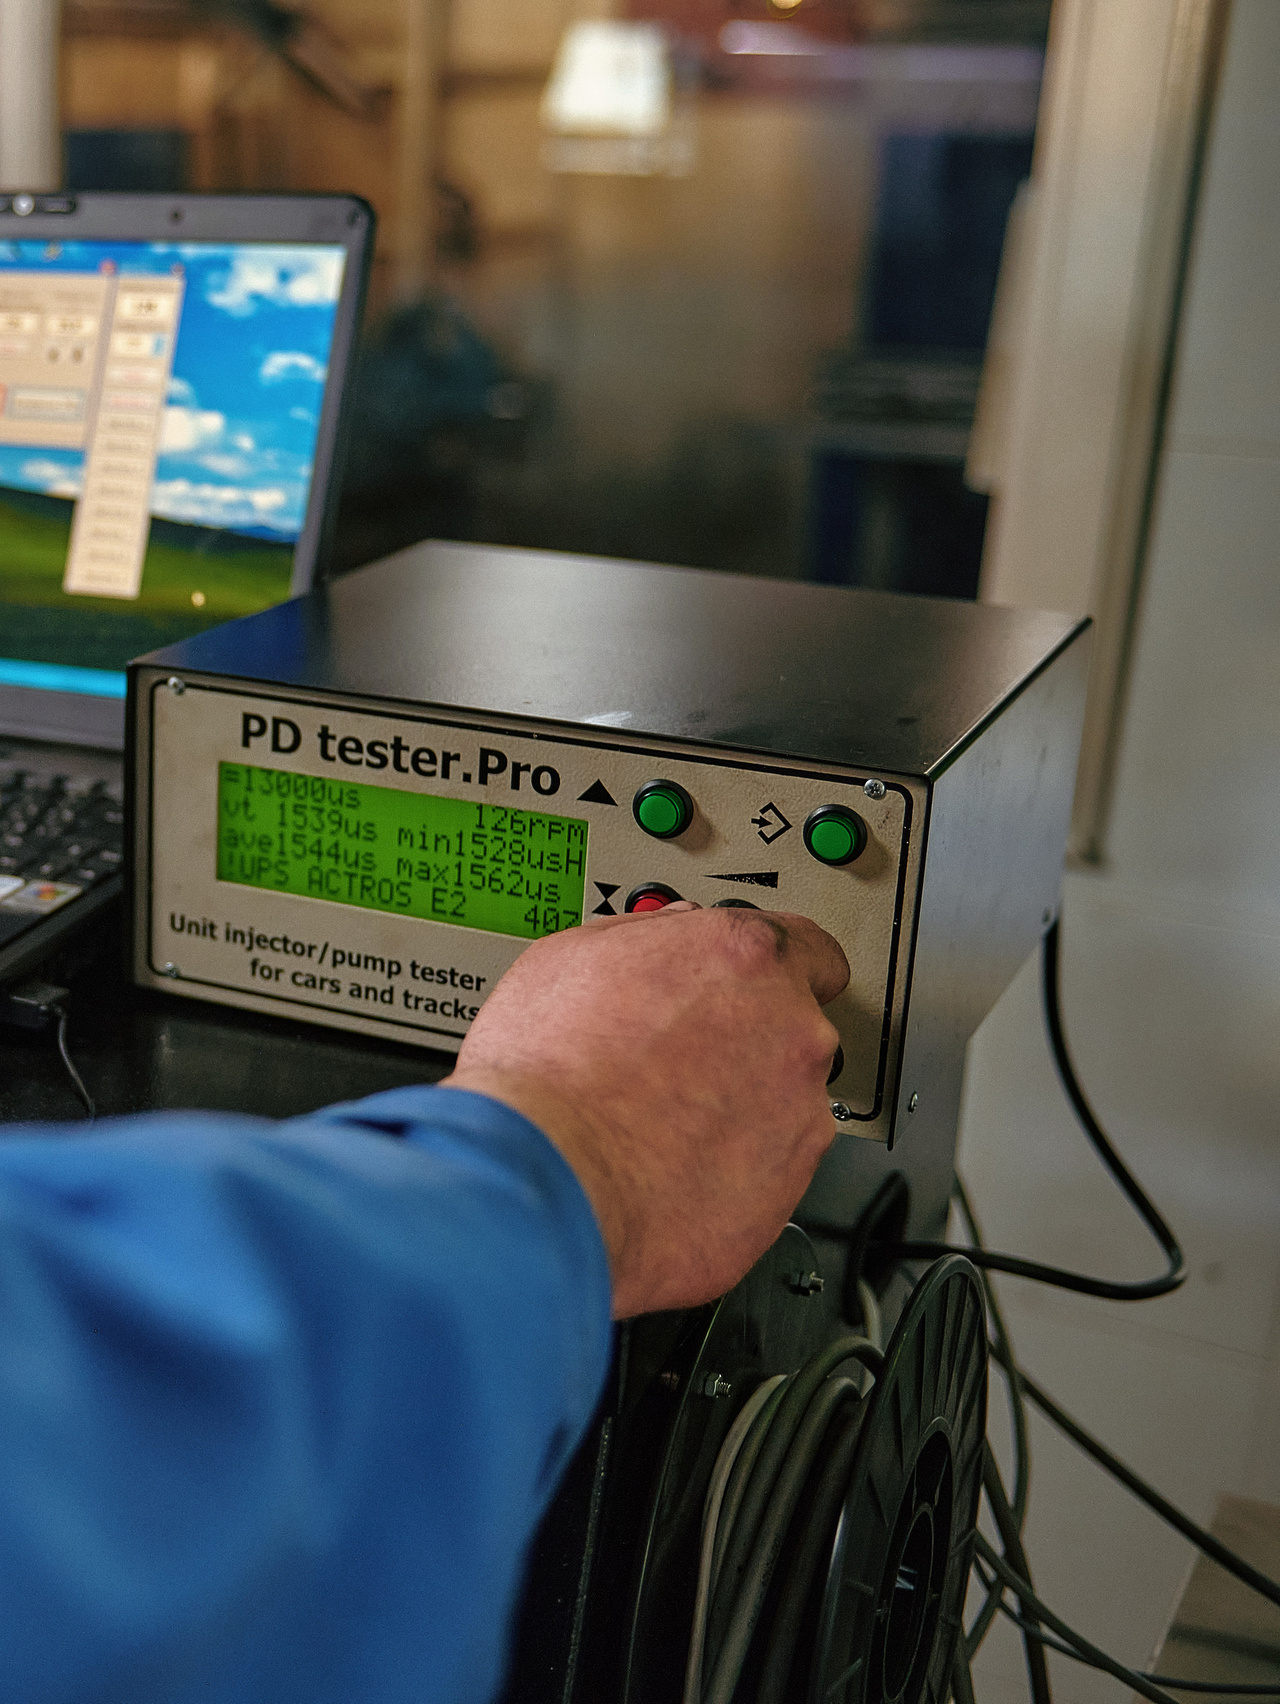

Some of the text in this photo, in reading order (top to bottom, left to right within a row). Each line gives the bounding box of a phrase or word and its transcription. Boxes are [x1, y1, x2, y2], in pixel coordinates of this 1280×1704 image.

[241, 712, 562, 796] PD tester.Pro
[278, 802, 379, 842] 1539us
[475, 802, 584, 846] 126rpm
[307, 864, 412, 908] ACTROS
[431, 886, 467, 918] E2
[170, 913, 488, 993] Unit injector/pump tester
[250, 957, 481, 1022] for cars and tracks
